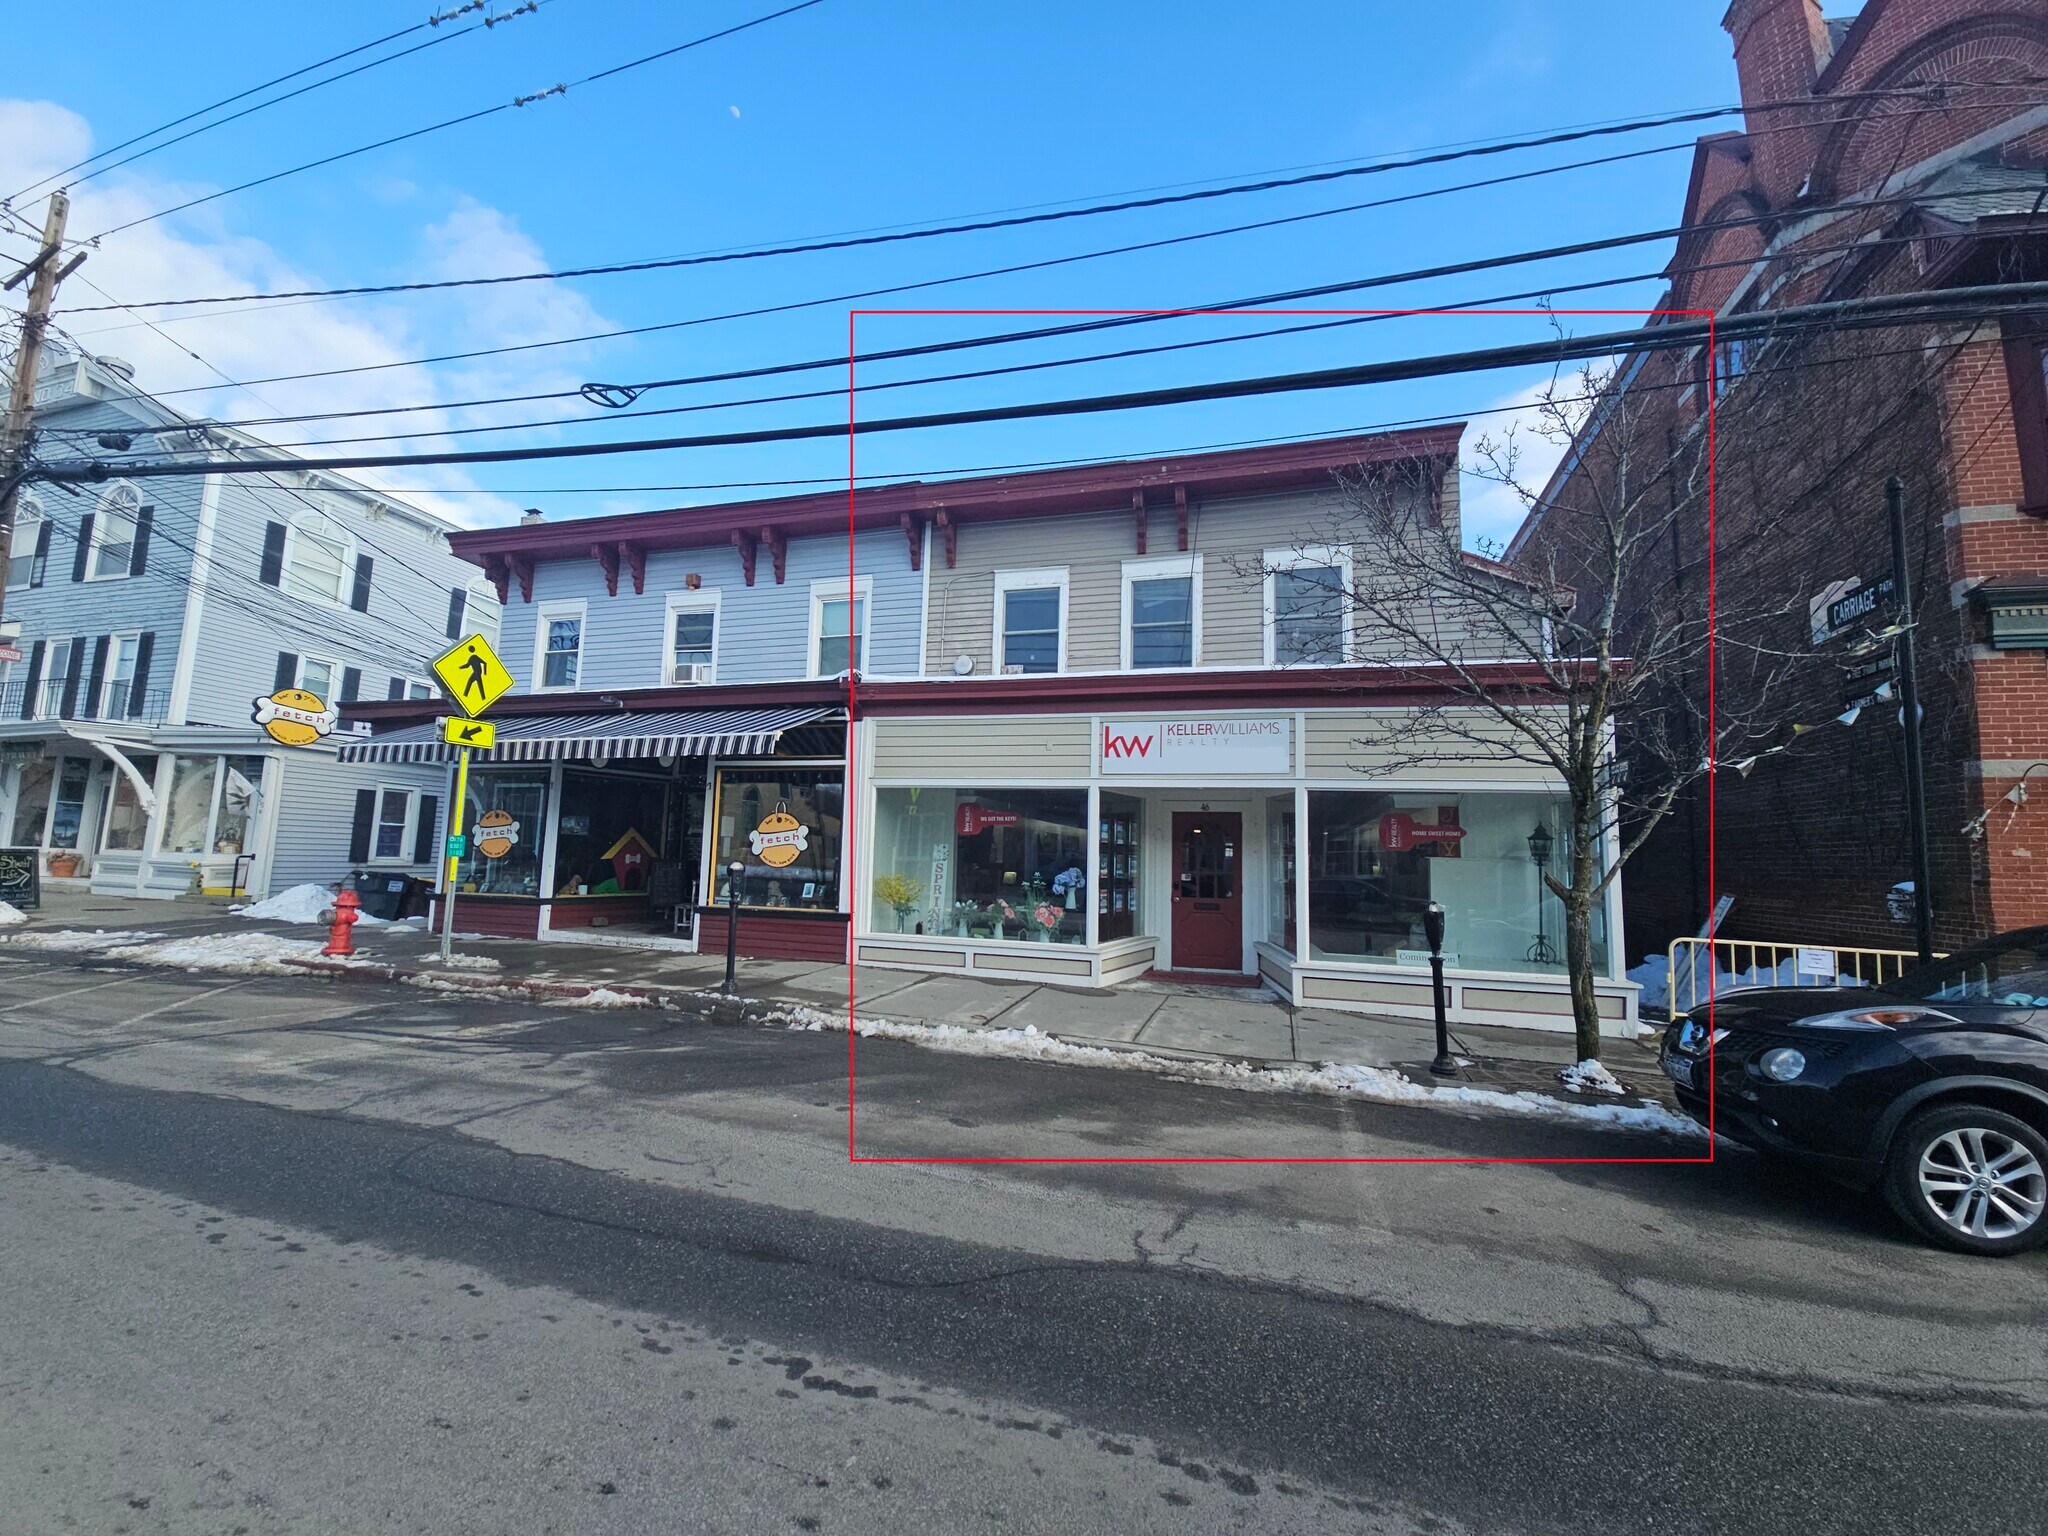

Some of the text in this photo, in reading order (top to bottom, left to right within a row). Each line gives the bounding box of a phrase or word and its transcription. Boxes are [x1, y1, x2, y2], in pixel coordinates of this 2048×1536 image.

[1833, 578, 1893, 625] CARRIAGE PATH
[274, 707, 325, 724] fetch
[1167, 737, 1230, 747] REALTY
[1200, 802, 1210, 811] 46
[481, 828, 512, 837] fetch
[760, 833, 800, 844] fetch
